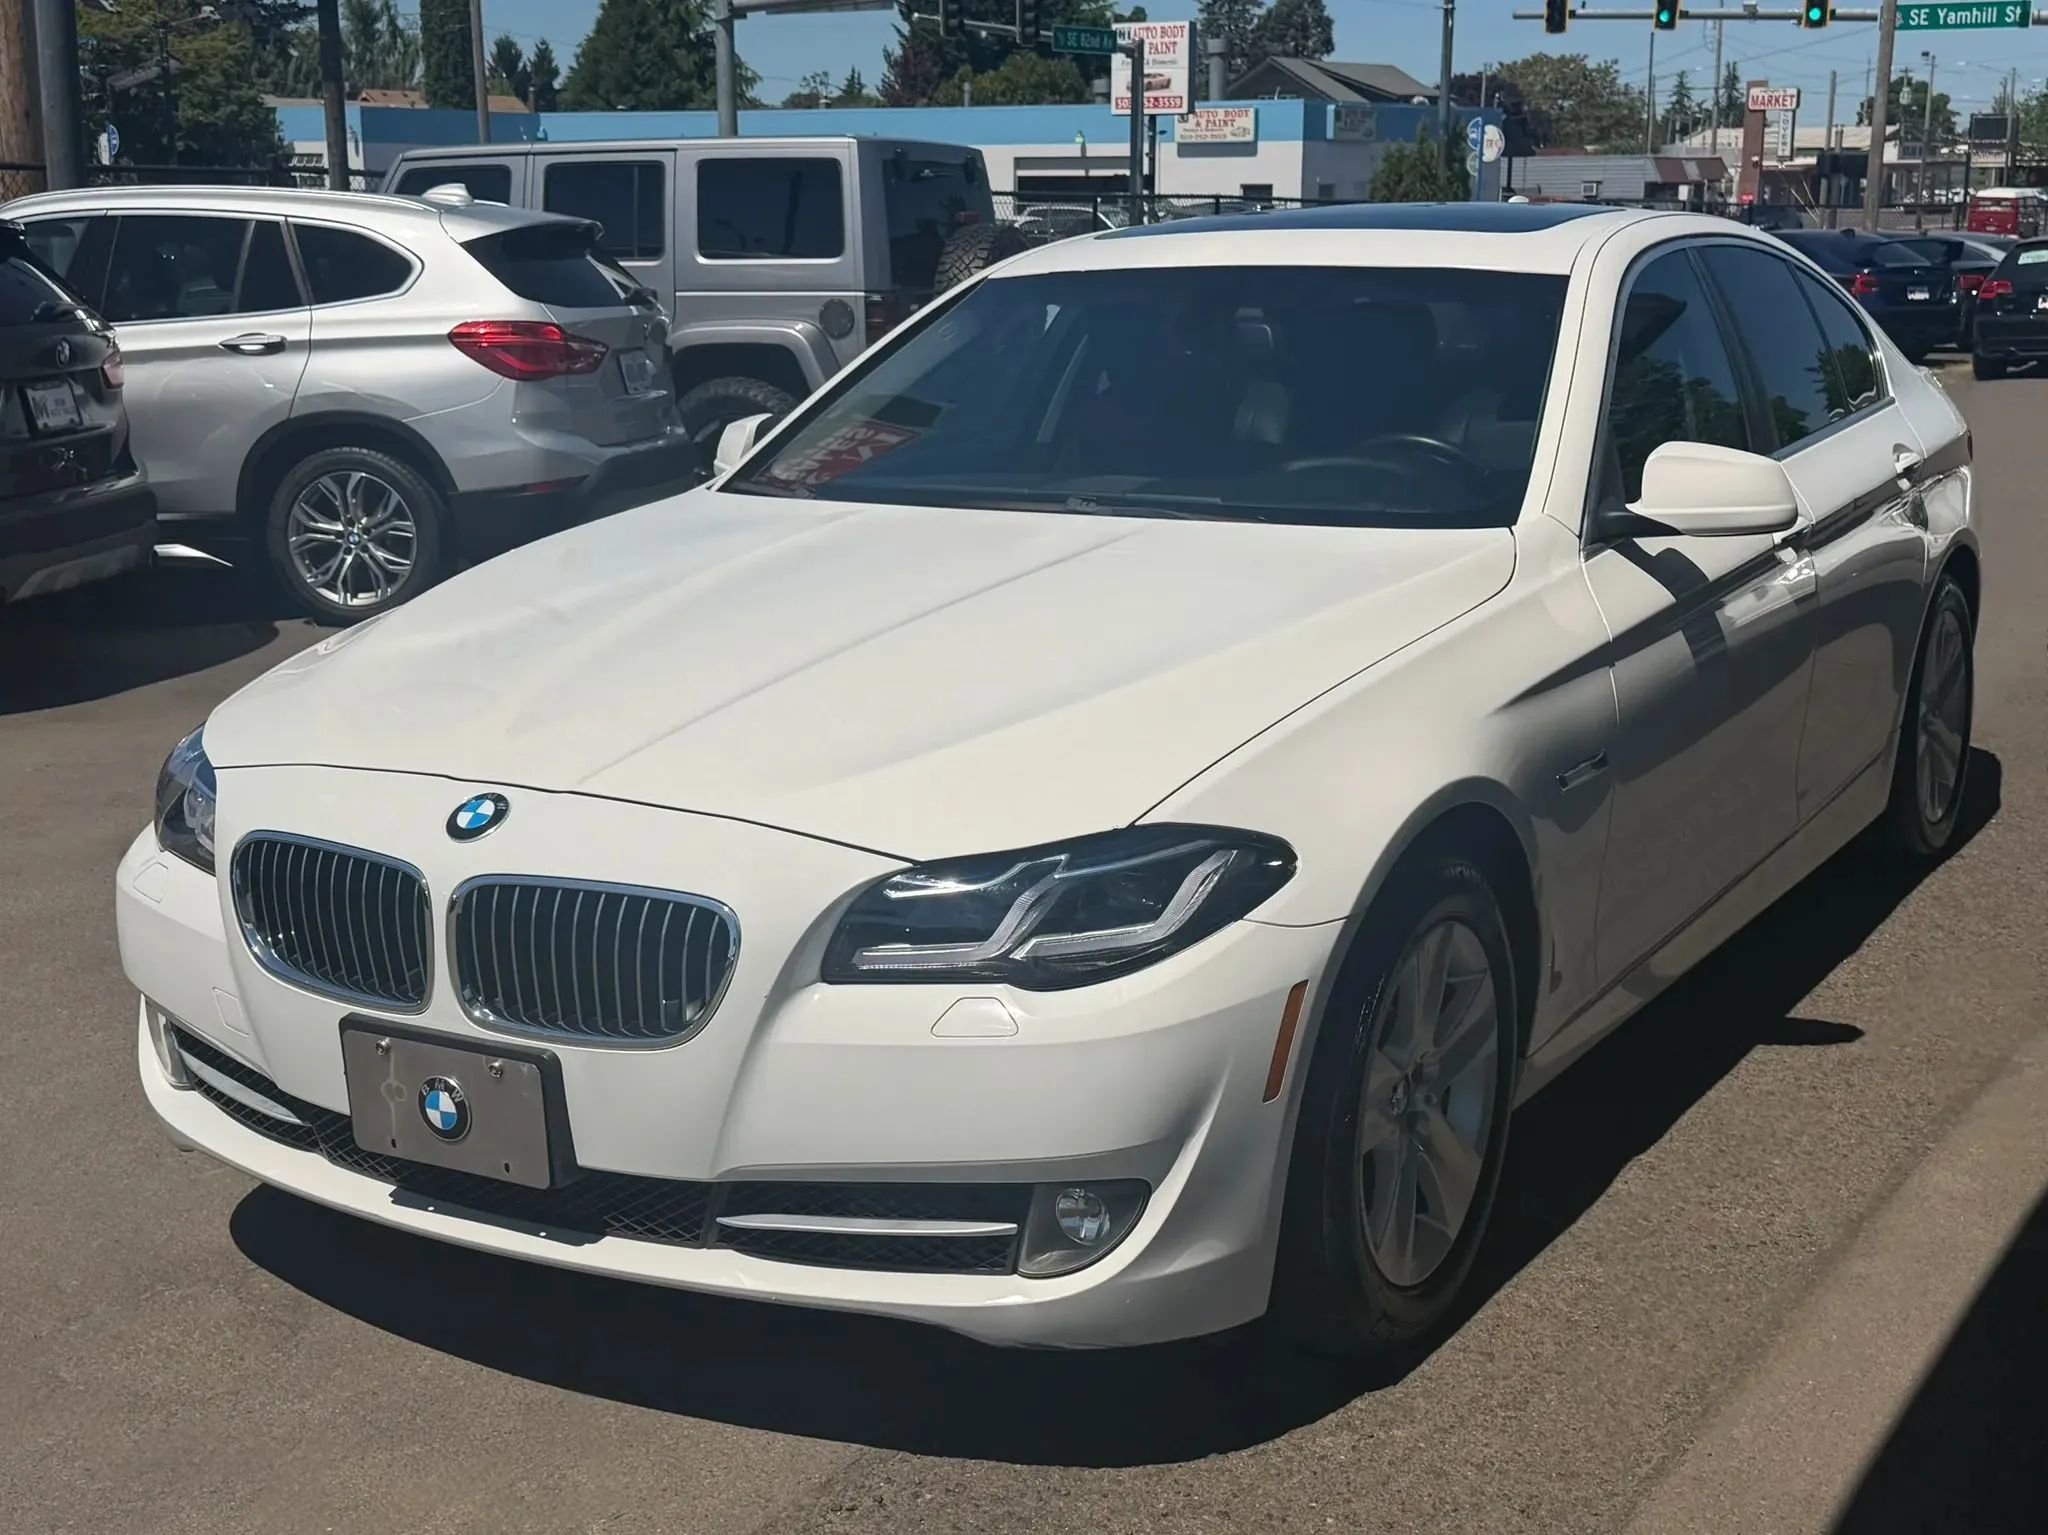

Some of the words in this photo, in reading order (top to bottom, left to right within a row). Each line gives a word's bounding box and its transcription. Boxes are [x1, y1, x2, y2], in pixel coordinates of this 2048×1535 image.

[1909, 8, 1930, 26] SE
[1937, 7, 1997, 25] Yamhill
[2004, 5, 2022, 23] St
[1134, 26, 1158, 40] AUTO
[1160, 25, 1186, 39] BODY
[1148, 41, 1178, 55] PAINT
[1751, 94, 1795, 108] MARKET
[1224, 110, 1250, 118] BODY
[1206, 119, 1236, 128] PAINT
[421, 1078, 464, 1103] BMW
